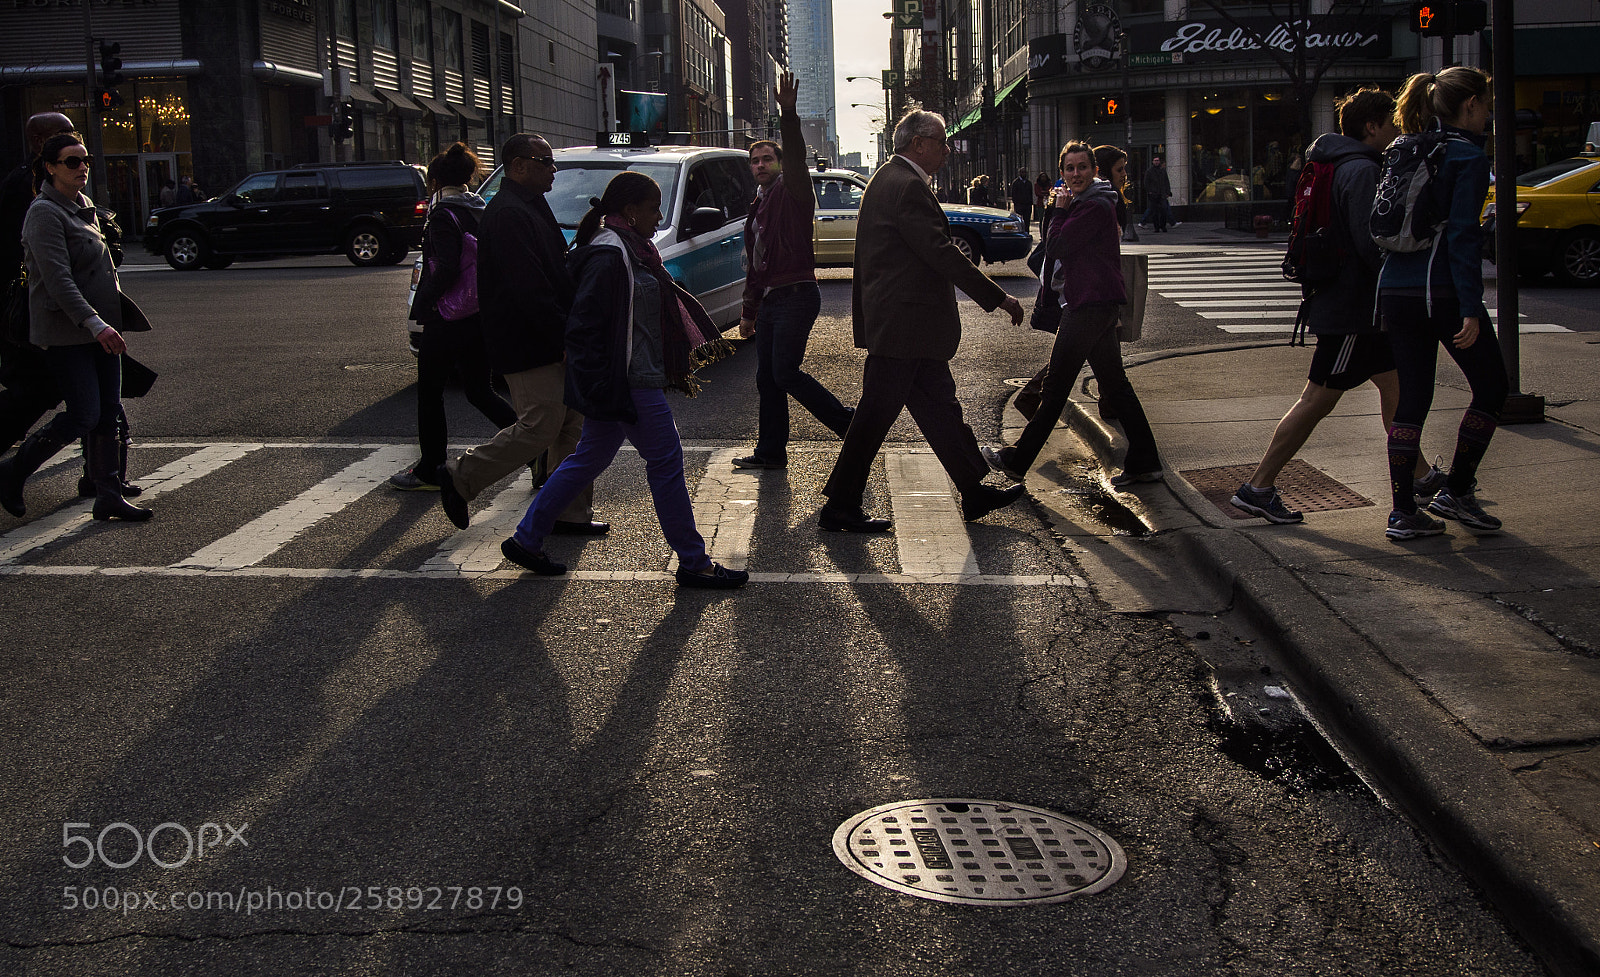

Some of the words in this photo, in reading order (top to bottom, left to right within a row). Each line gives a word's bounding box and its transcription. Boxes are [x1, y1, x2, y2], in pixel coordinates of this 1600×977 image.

[272, 2, 316, 24] FOREVER
[905, 1, 919, 15] P
[1160, 23, 1261, 53] Eddie
[1263, 19, 1377, 53] Bauer
[1135, 55, 1165, 65] Michigan
[888, 72, 898, 83] P
[609, 133, 630, 144] 2745
[914, 831, 948, 868] CHICAGO
